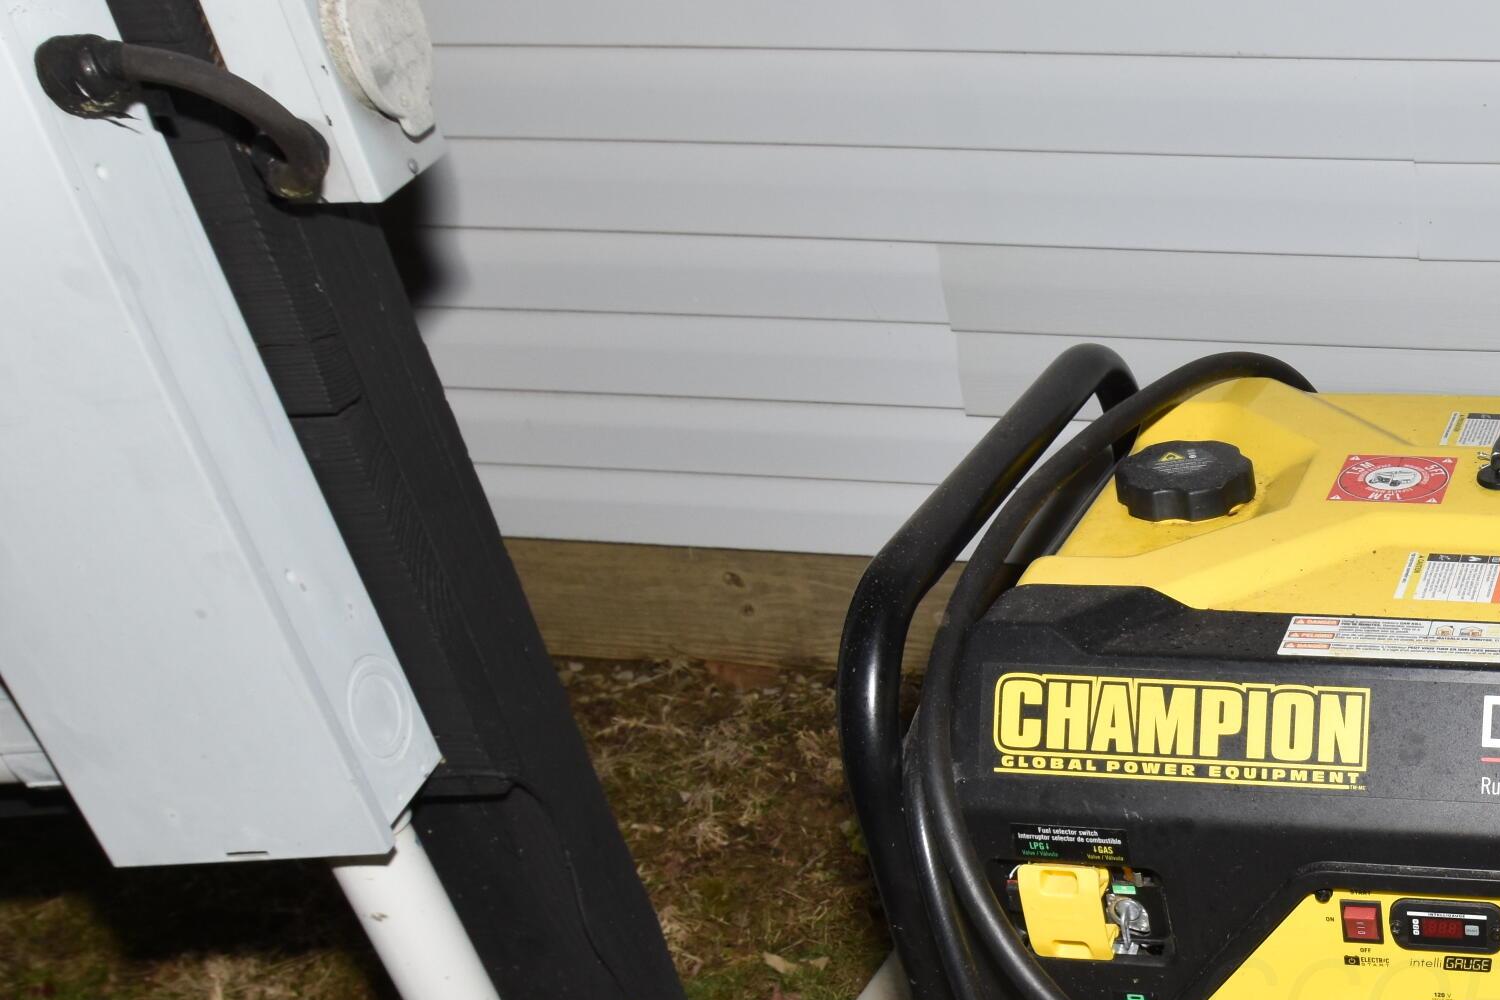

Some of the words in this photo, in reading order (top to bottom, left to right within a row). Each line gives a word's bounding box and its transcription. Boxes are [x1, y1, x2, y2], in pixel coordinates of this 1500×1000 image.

[1001, 680, 1363, 764] CHAMPION
[1001, 755, 1097, 772] GLOBAL
[1107, 761, 1196, 777] POWER
[1209, 767, 1359, 784] EQUIPMENT
[1053, 827, 1077, 836] selector
[1051, 834, 1075, 842] selector
[1029, 842, 1044, 850] LPG
[1097, 846, 1114, 854] GAS
